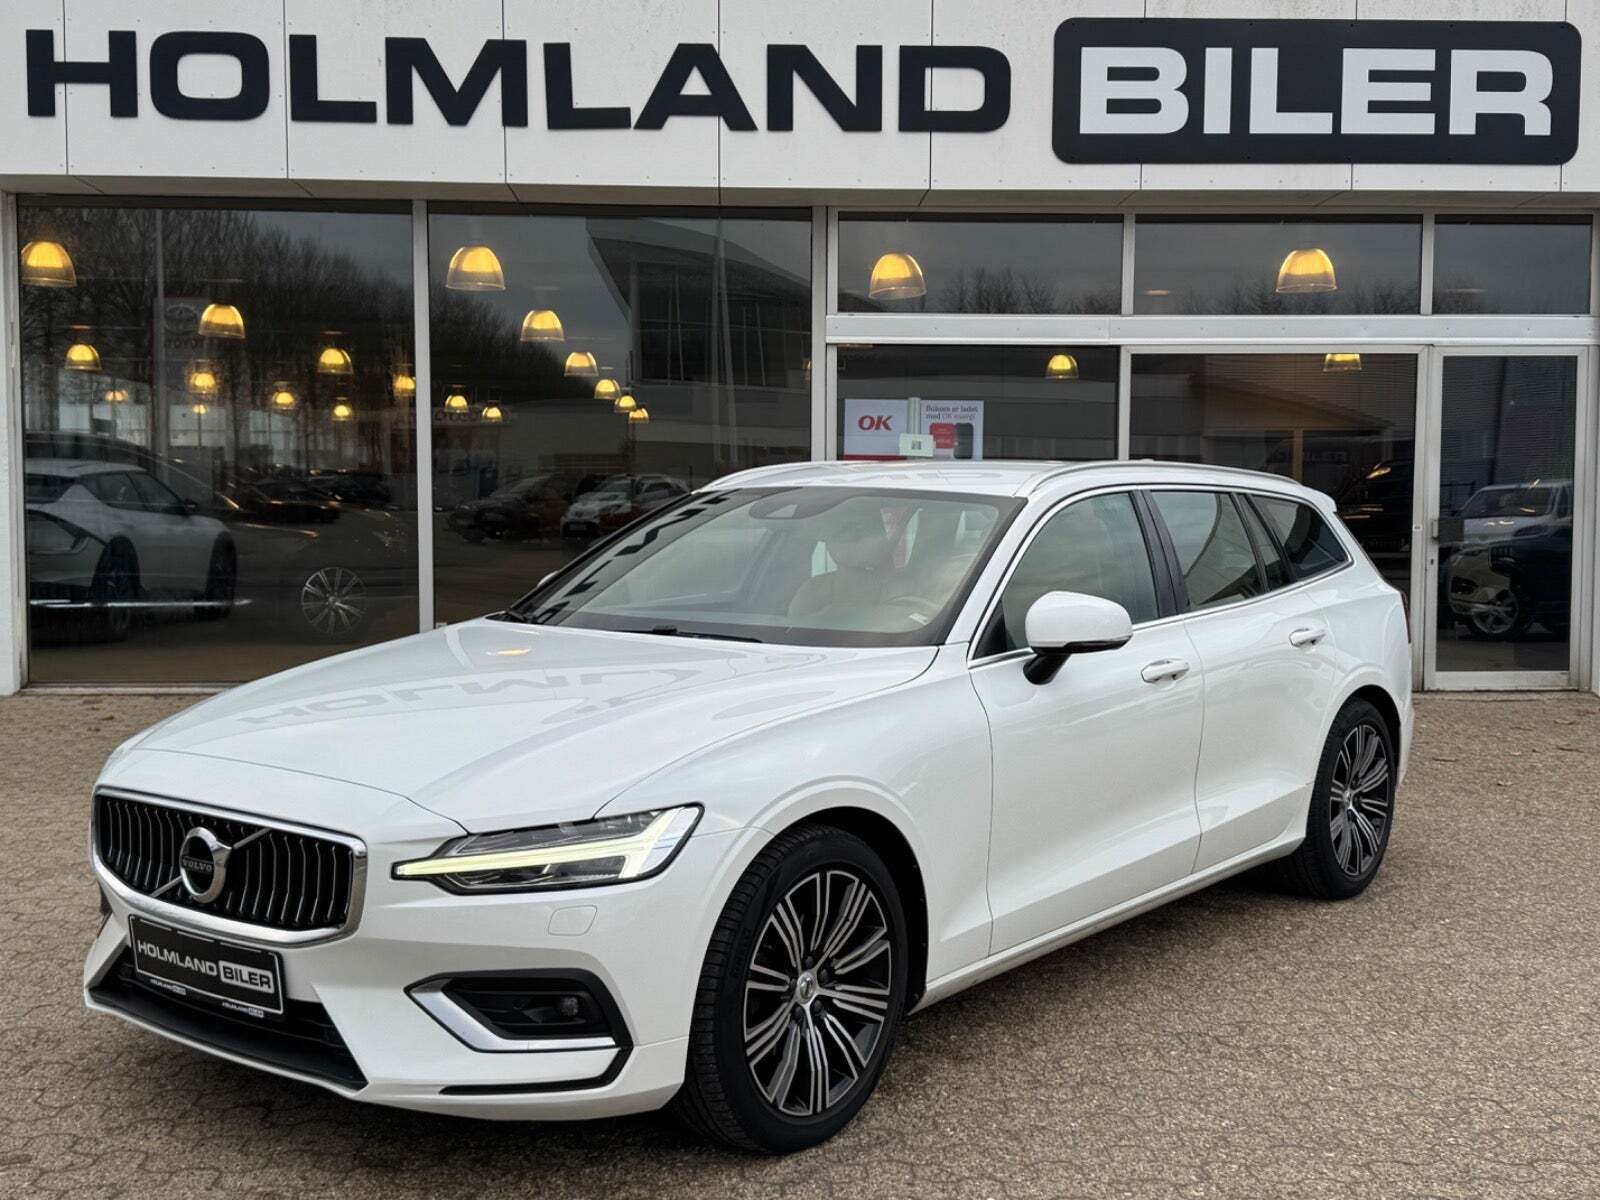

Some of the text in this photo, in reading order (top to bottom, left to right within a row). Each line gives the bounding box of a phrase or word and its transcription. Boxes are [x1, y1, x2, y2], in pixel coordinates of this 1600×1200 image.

[26, 29, 1554, 136] HOLMLAND BILER
[857, 415, 892, 431] OK
[182, 858, 213, 871] VOLVO
[137, 939, 272, 990] HOLMLAND BILER
